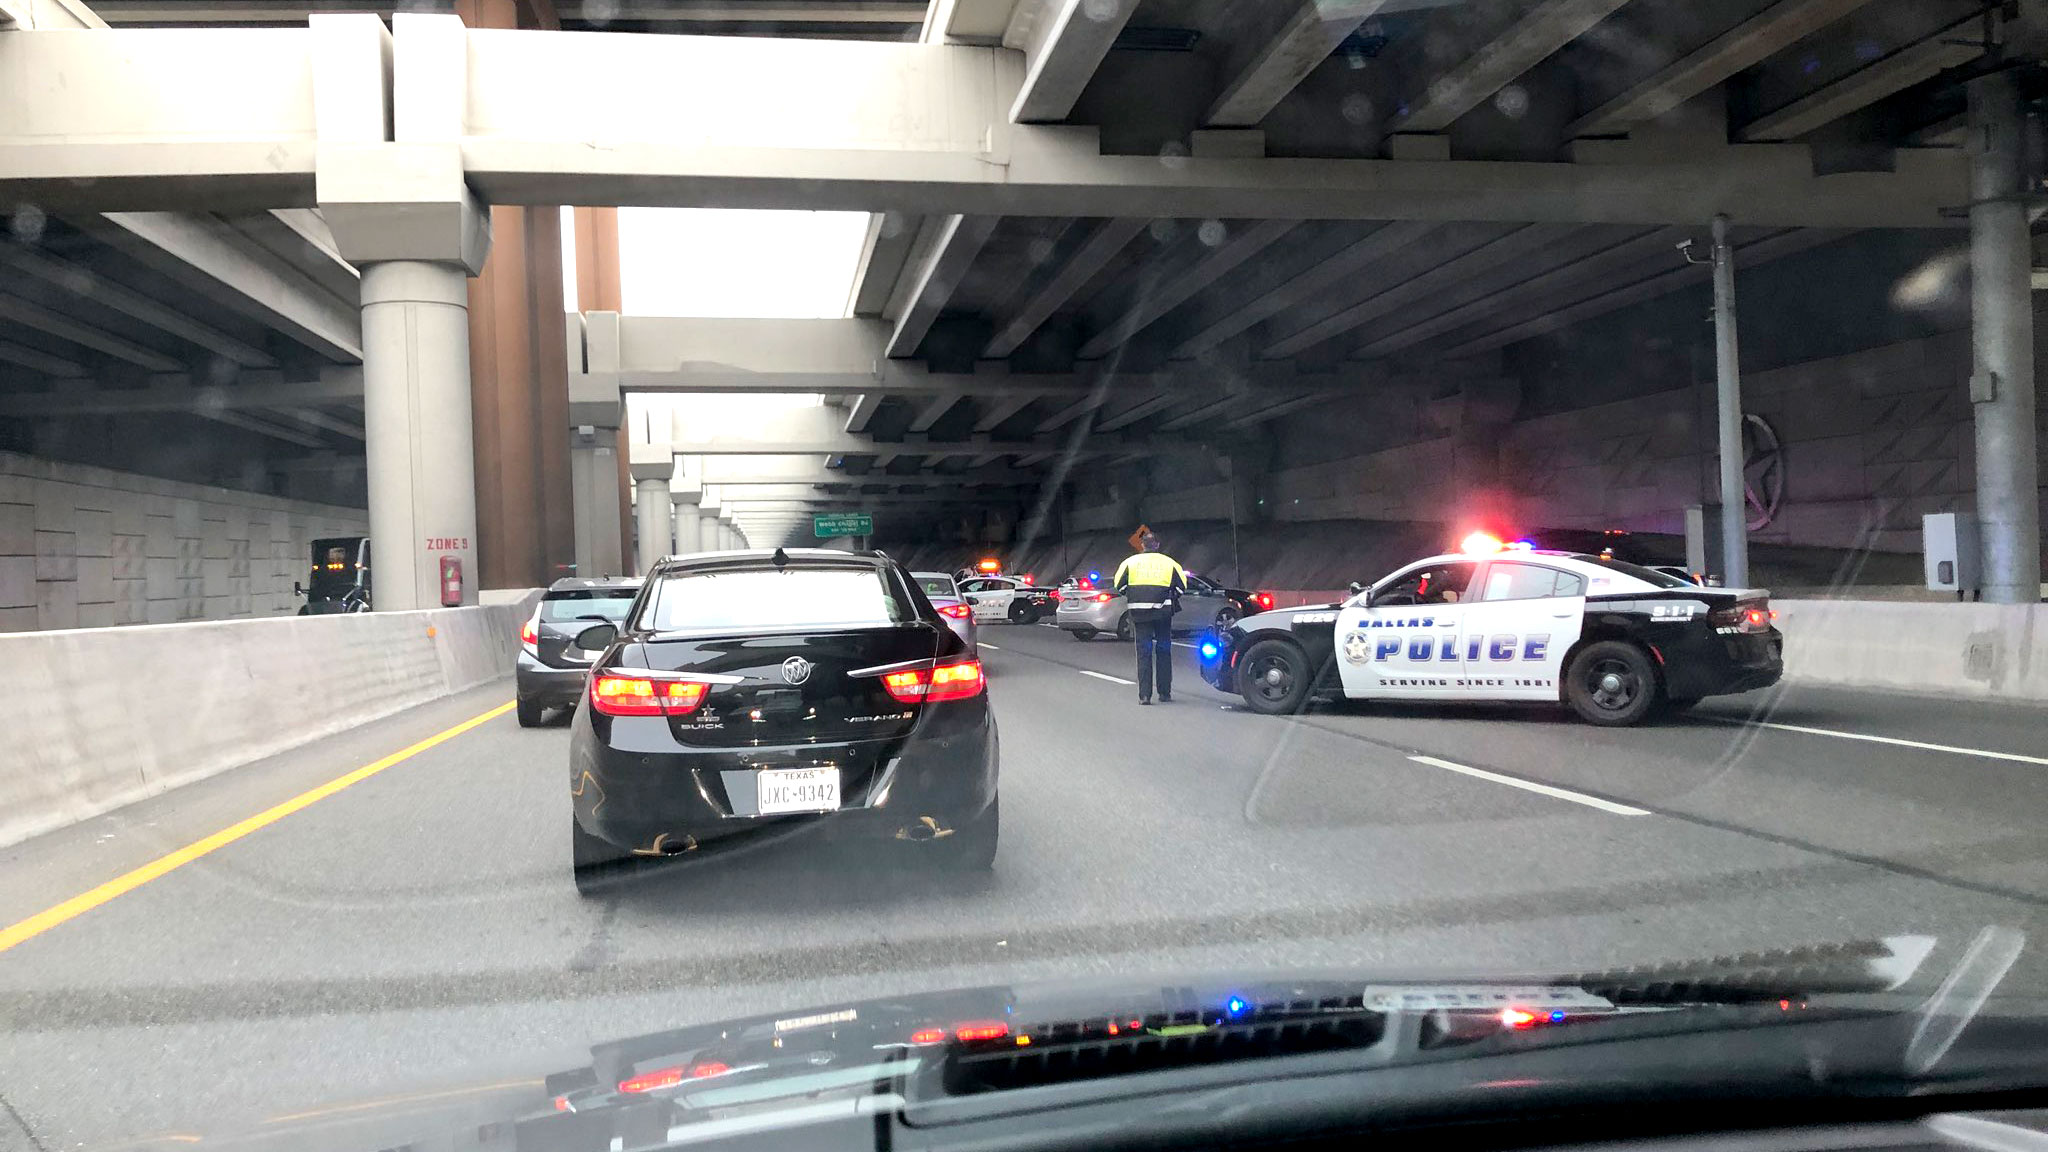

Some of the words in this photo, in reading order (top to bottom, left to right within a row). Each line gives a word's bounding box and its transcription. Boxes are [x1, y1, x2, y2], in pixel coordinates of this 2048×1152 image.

[427, 538, 459, 550] ZONE
[462, 538, 468, 550] 9
[1358, 616, 1435, 627] DALLAS
[1375, 633, 1551, 662] POLICE
[844, 714, 901, 722] VERANO
[784, 771, 815, 780] TEXAS
